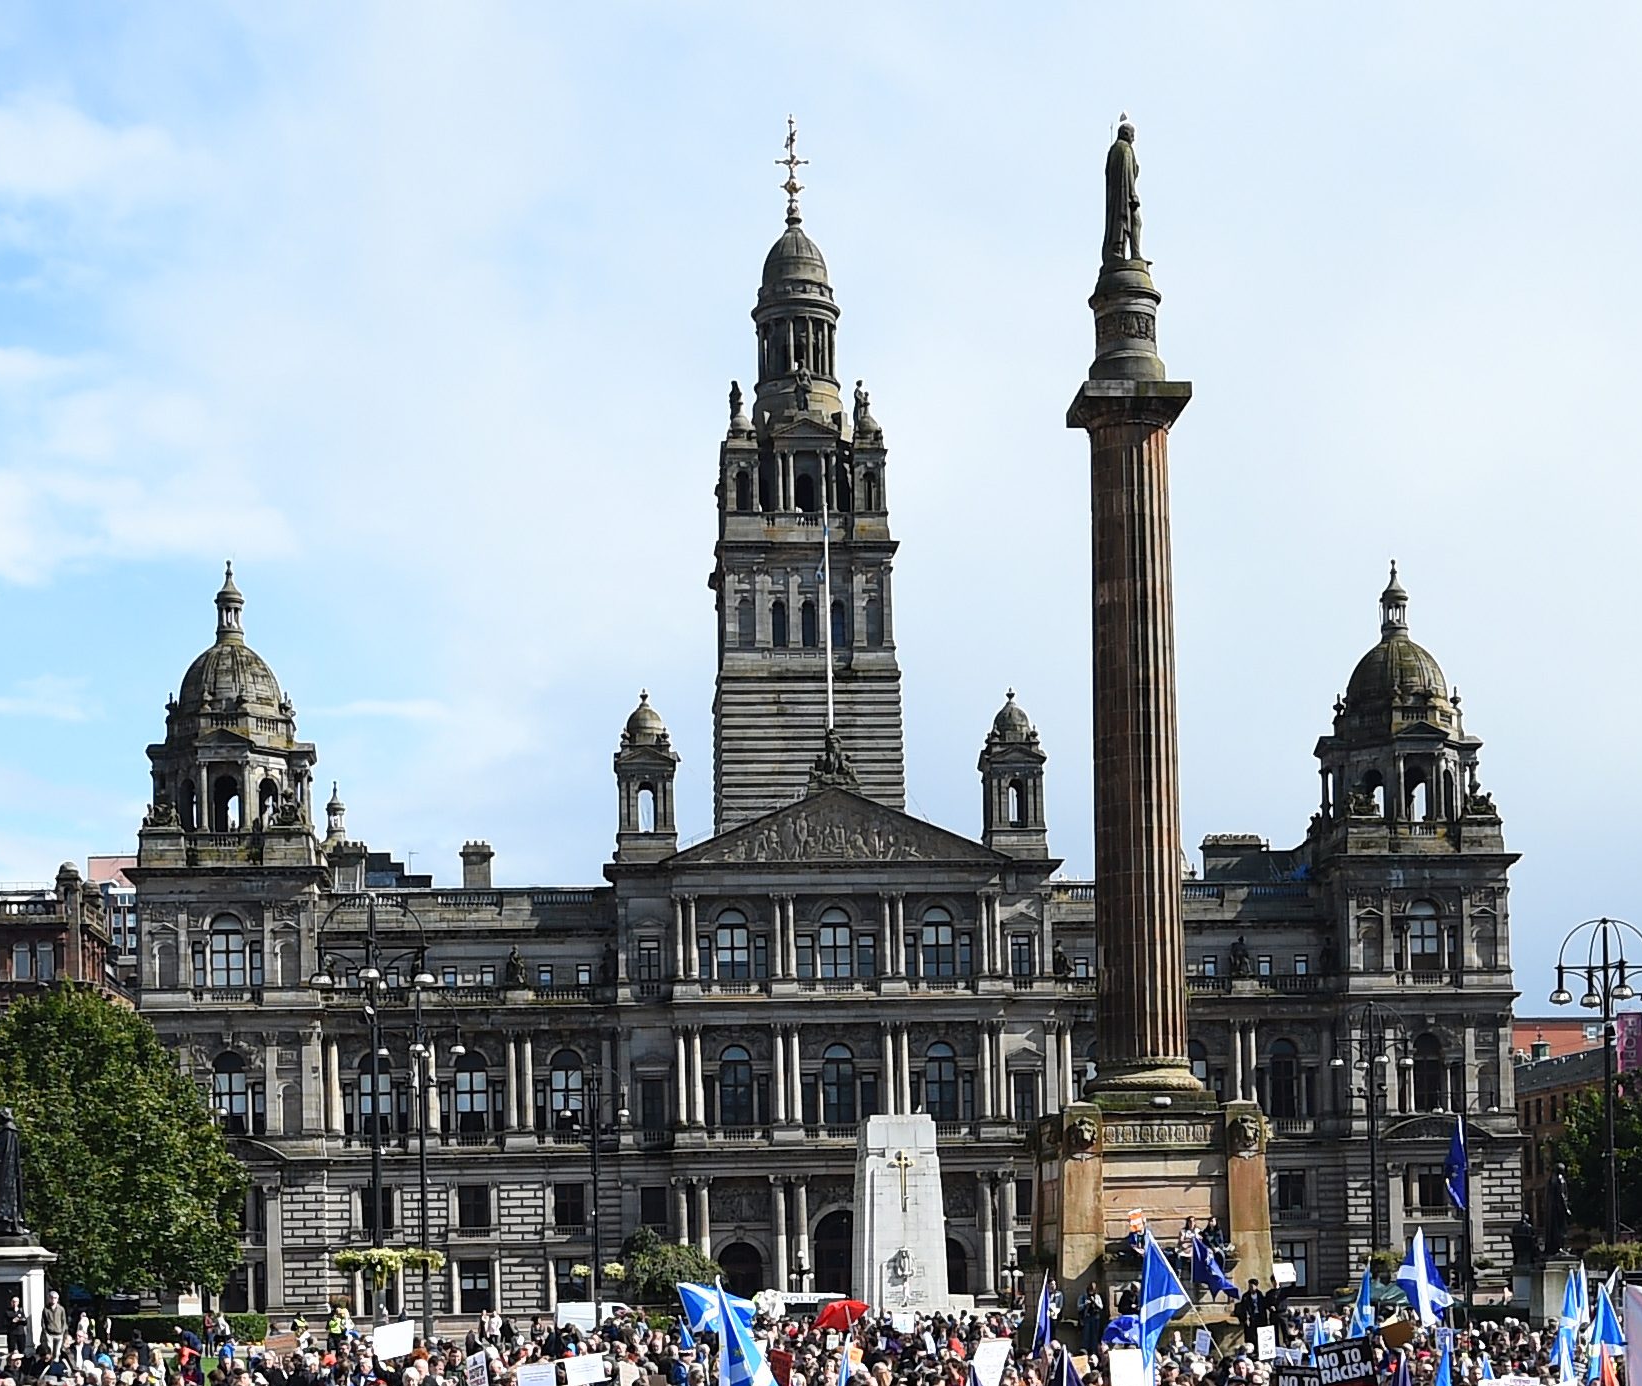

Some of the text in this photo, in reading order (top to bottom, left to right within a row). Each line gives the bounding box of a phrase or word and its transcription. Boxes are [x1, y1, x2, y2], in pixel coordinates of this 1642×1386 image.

[780, 1295, 822, 1303] POLIC
[1317, 1347, 1362, 1370] NO TO
[1320, 1360, 1374, 1385] RACISM
